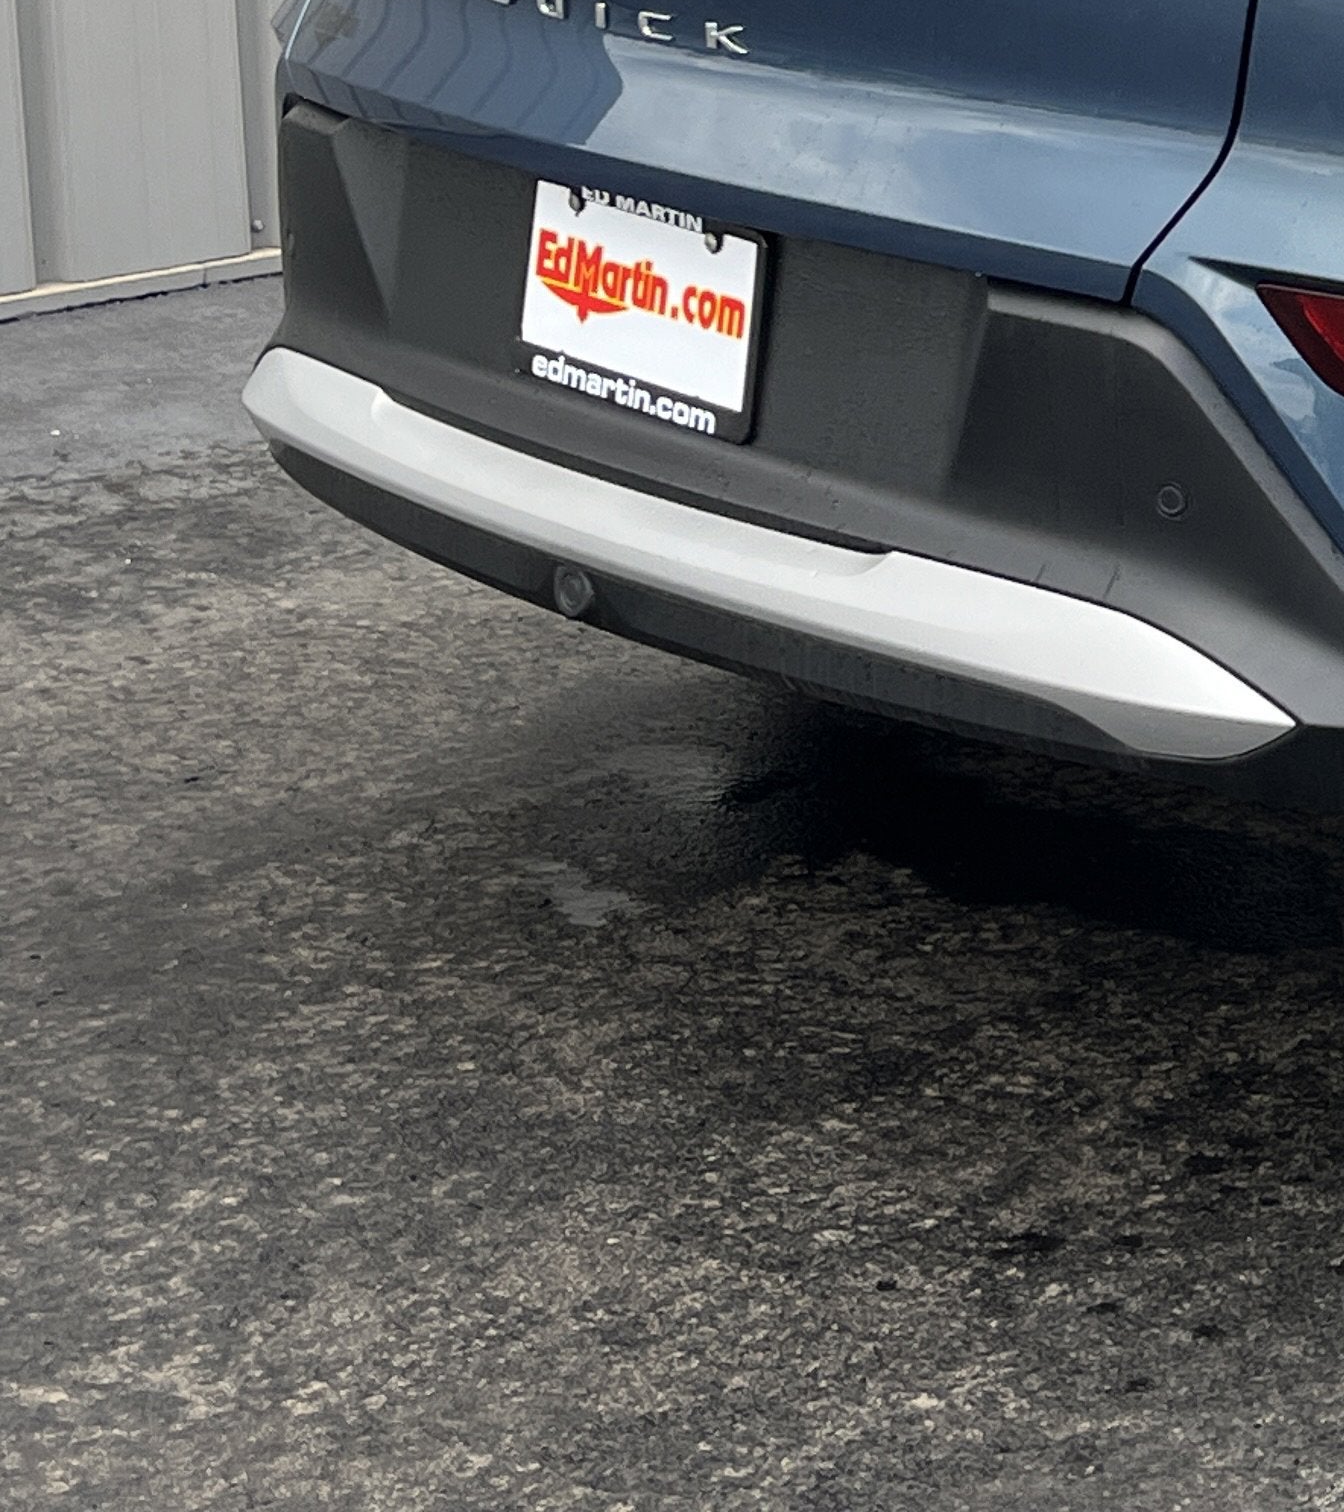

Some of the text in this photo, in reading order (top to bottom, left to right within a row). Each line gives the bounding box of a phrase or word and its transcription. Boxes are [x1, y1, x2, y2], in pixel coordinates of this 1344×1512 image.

[615, 194, 703, 233] MARTIN
[535, 227, 746, 340] EdMartin.com
[531, 353, 717, 435] edmartin.com
